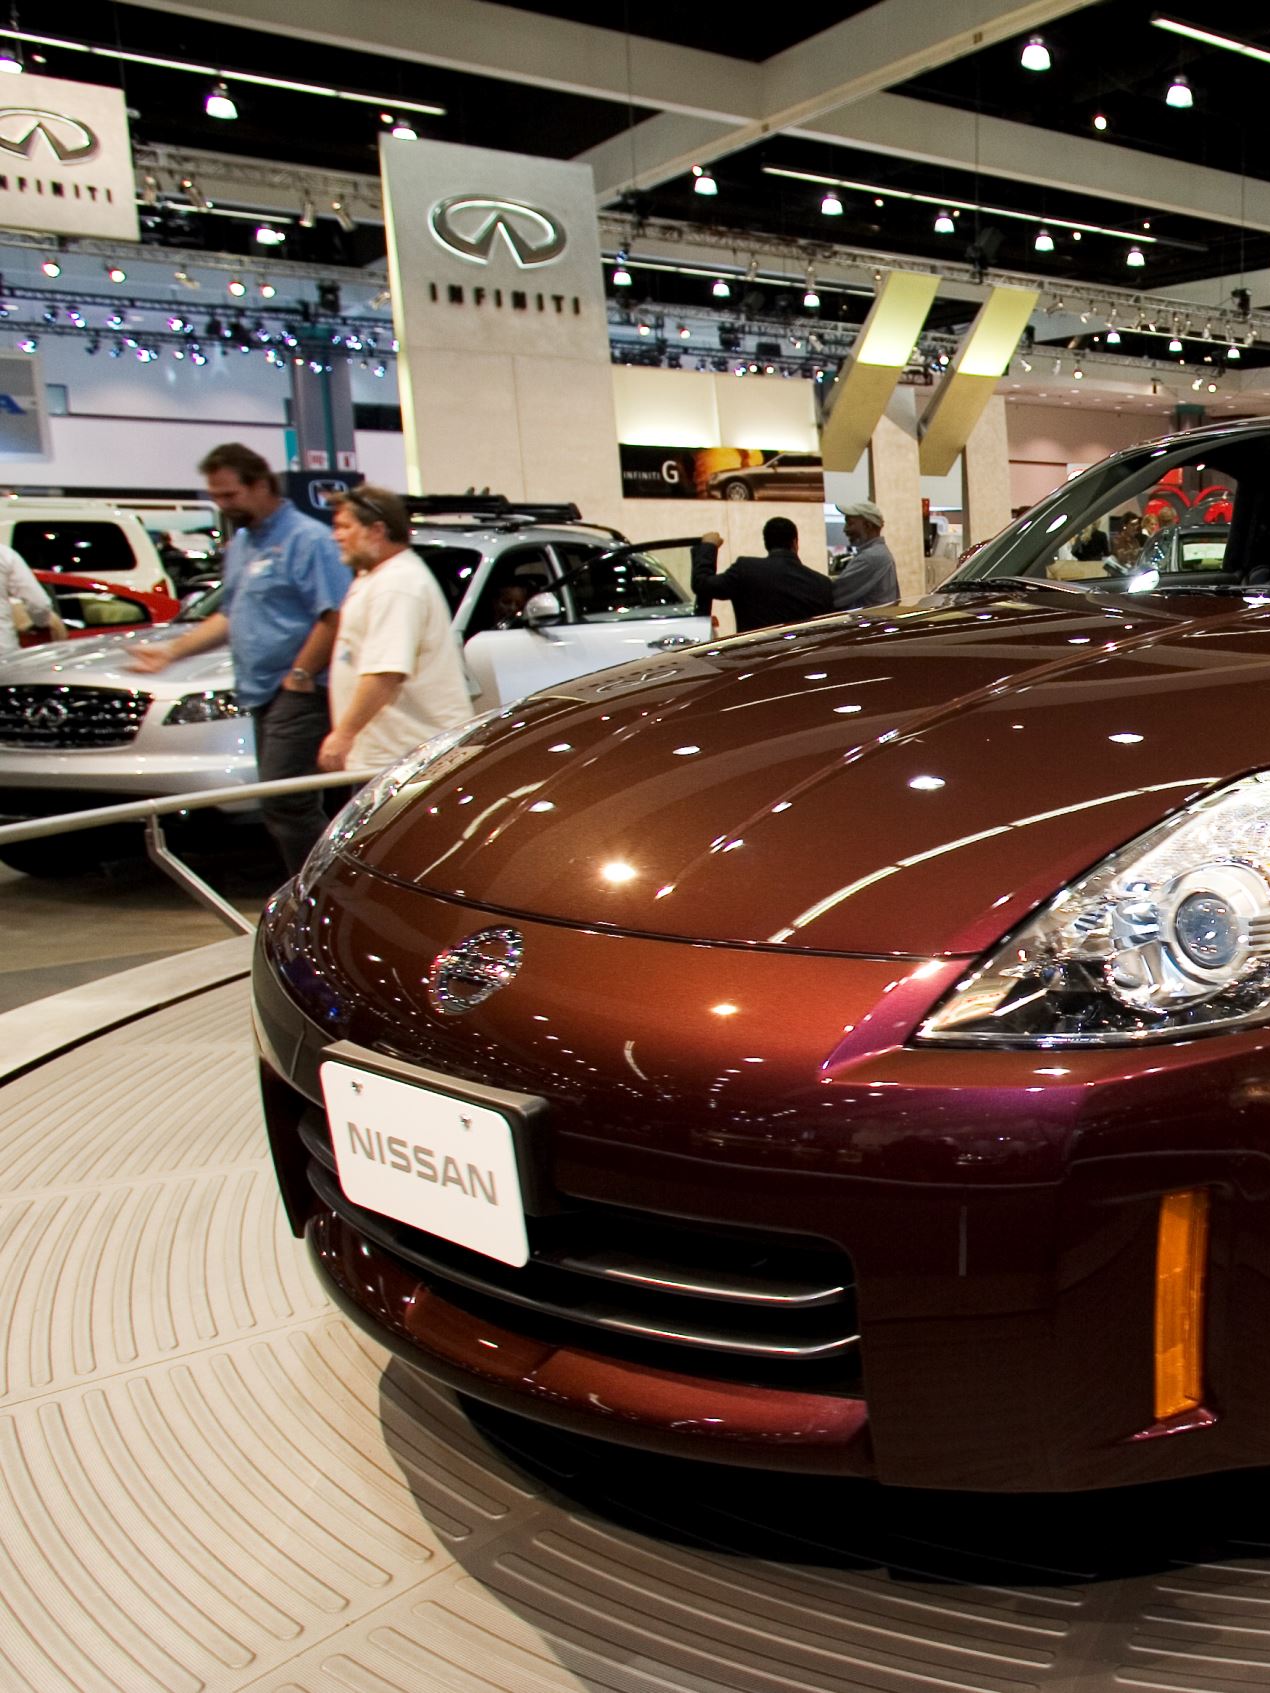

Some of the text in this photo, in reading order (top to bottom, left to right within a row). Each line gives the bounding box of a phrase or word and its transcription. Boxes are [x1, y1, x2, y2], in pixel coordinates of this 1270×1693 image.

[429, 282, 580, 316] INFINITI
[623, 460, 680, 484] INFINITI G
[347, 1121, 499, 1206] NISSAN
